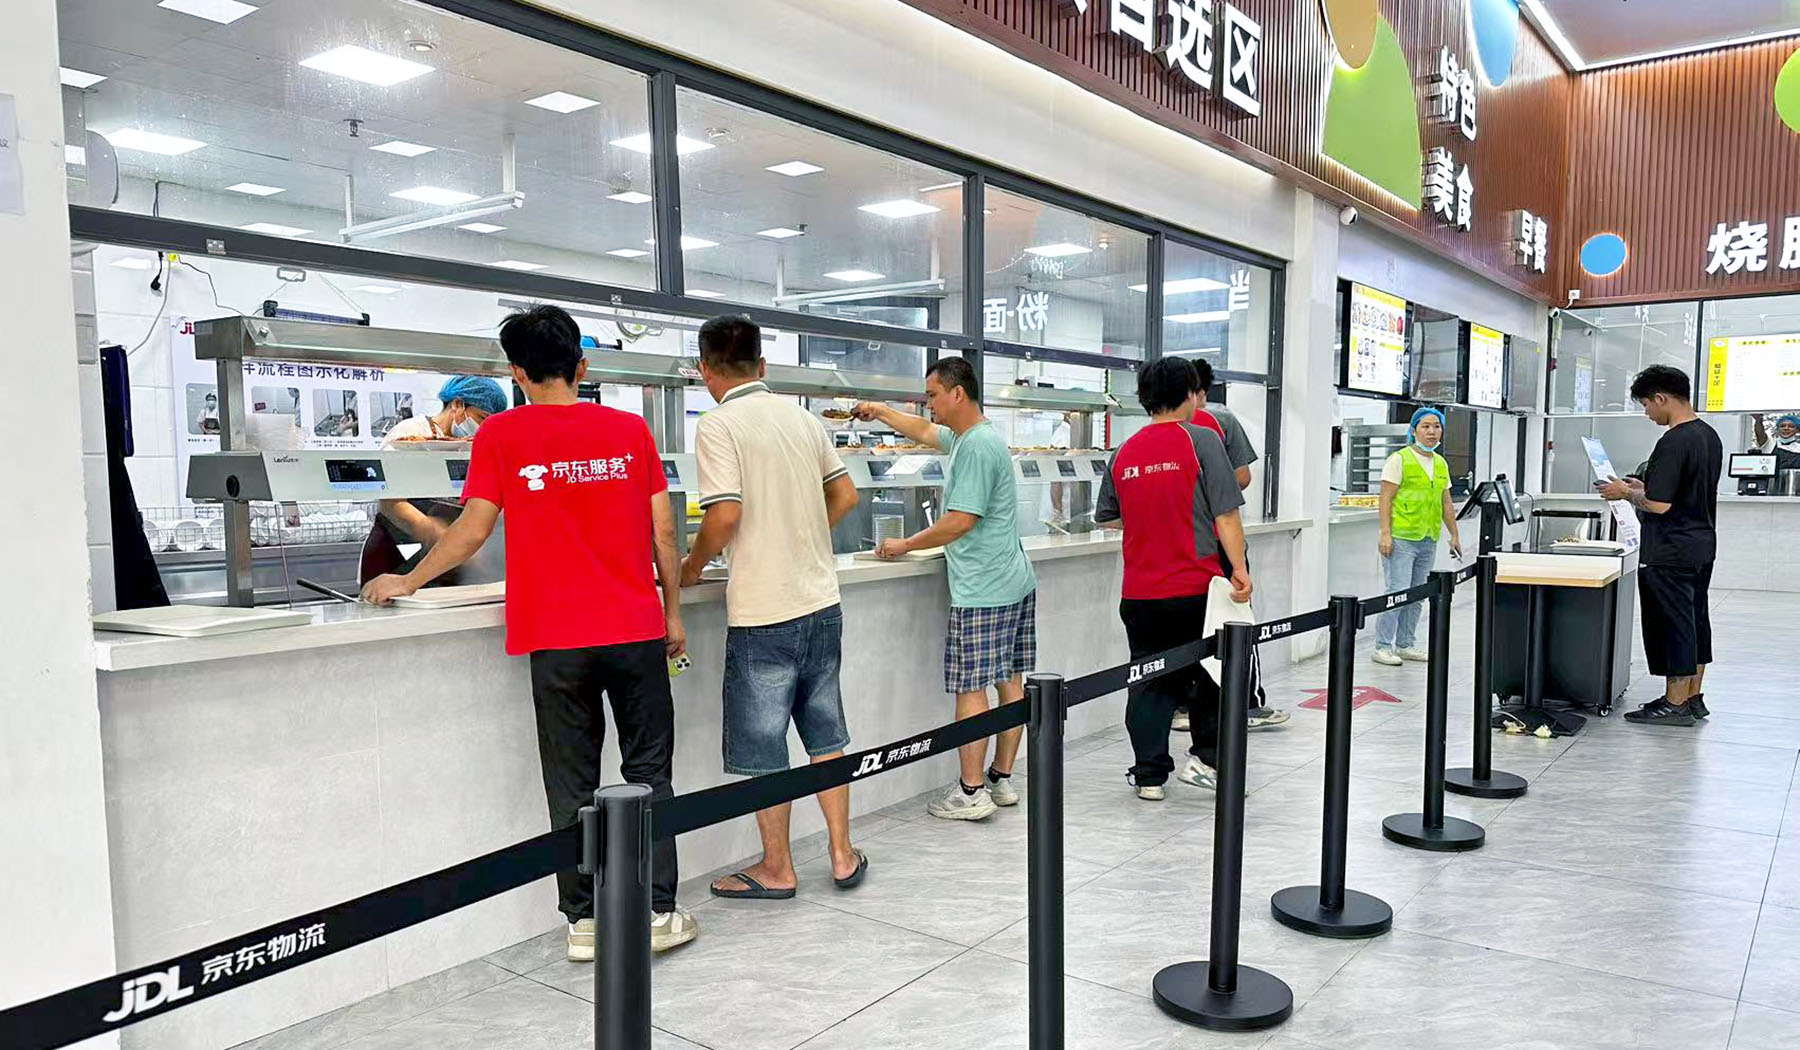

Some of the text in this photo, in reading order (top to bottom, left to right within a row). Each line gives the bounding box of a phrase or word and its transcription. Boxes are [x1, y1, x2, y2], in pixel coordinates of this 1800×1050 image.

[1440, 45, 1476, 141] 特色
[1433, 147, 1474, 232] 美食
[1519, 209, 1548, 274] 早餐
[566, 472, 628, 484] JD Service Plus
[1258, 625, 1272, 641] JDL
[1127, 664, 1142, 683] JDL
[852, 739, 932, 777] JDL 京东物流
[102, 923, 326, 1022] JDL 京东物流
